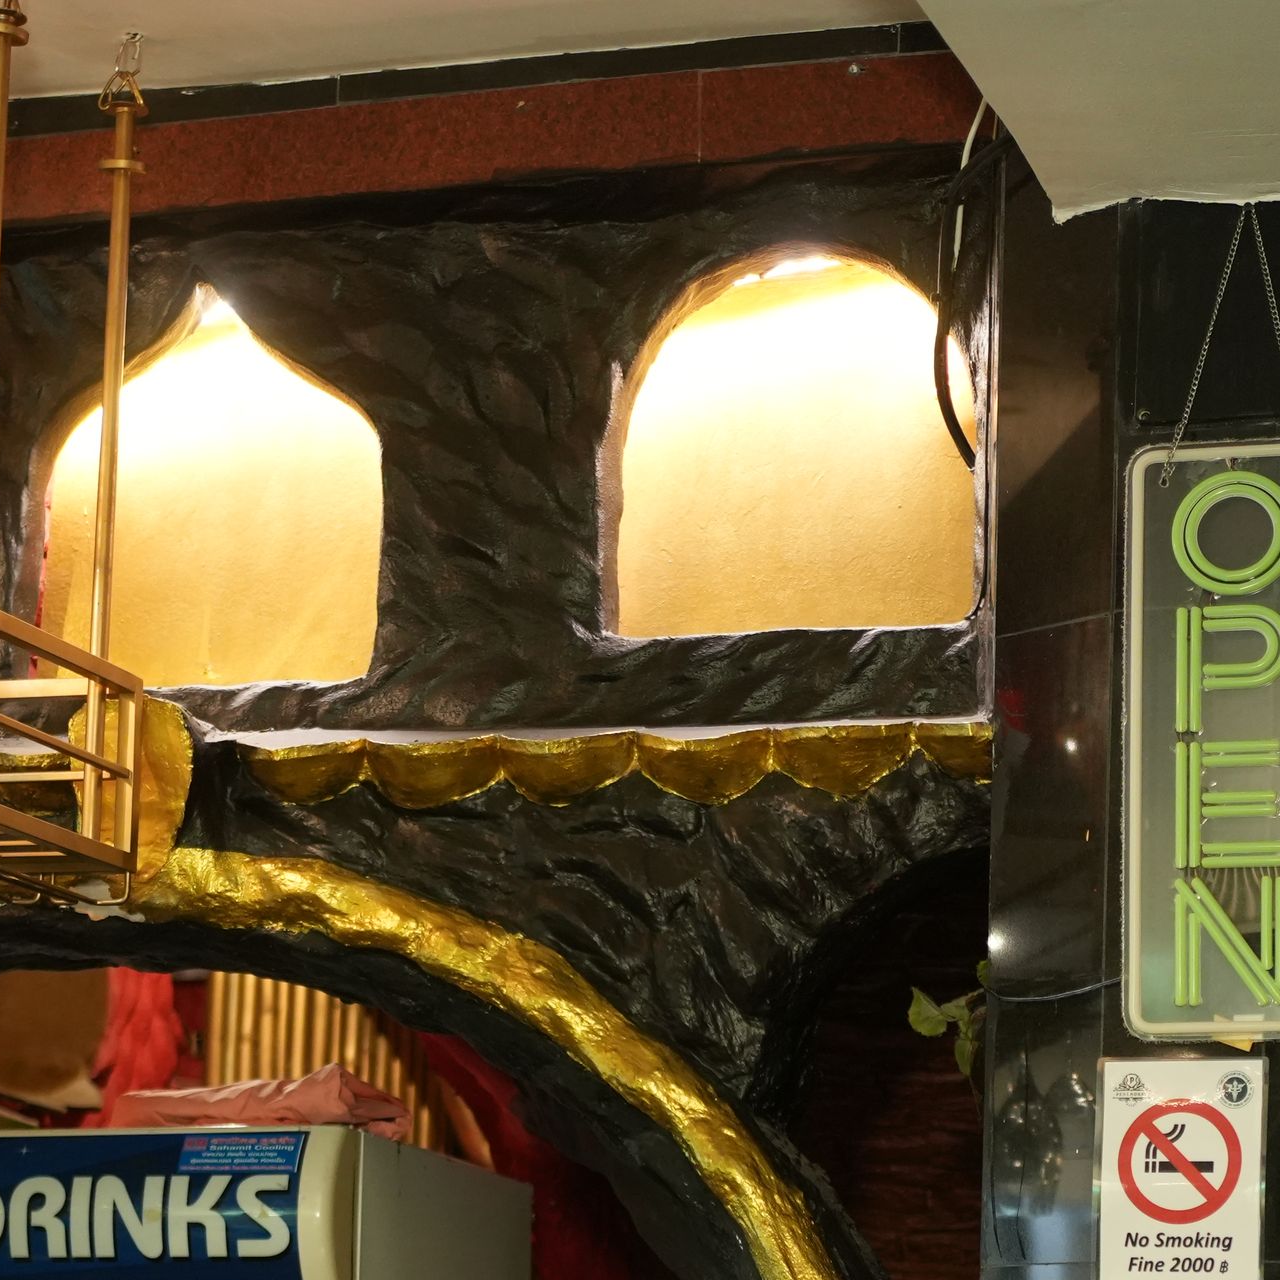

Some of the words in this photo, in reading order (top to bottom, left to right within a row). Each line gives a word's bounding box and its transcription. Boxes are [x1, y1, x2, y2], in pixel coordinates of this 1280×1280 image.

[1124, 1232, 1150, 1248] No
[1154, 1231, 1233, 1251] Smoking
[1128, 1257, 1165, 1273] Fine
[1170, 1257, 1215, 1273] 2000
